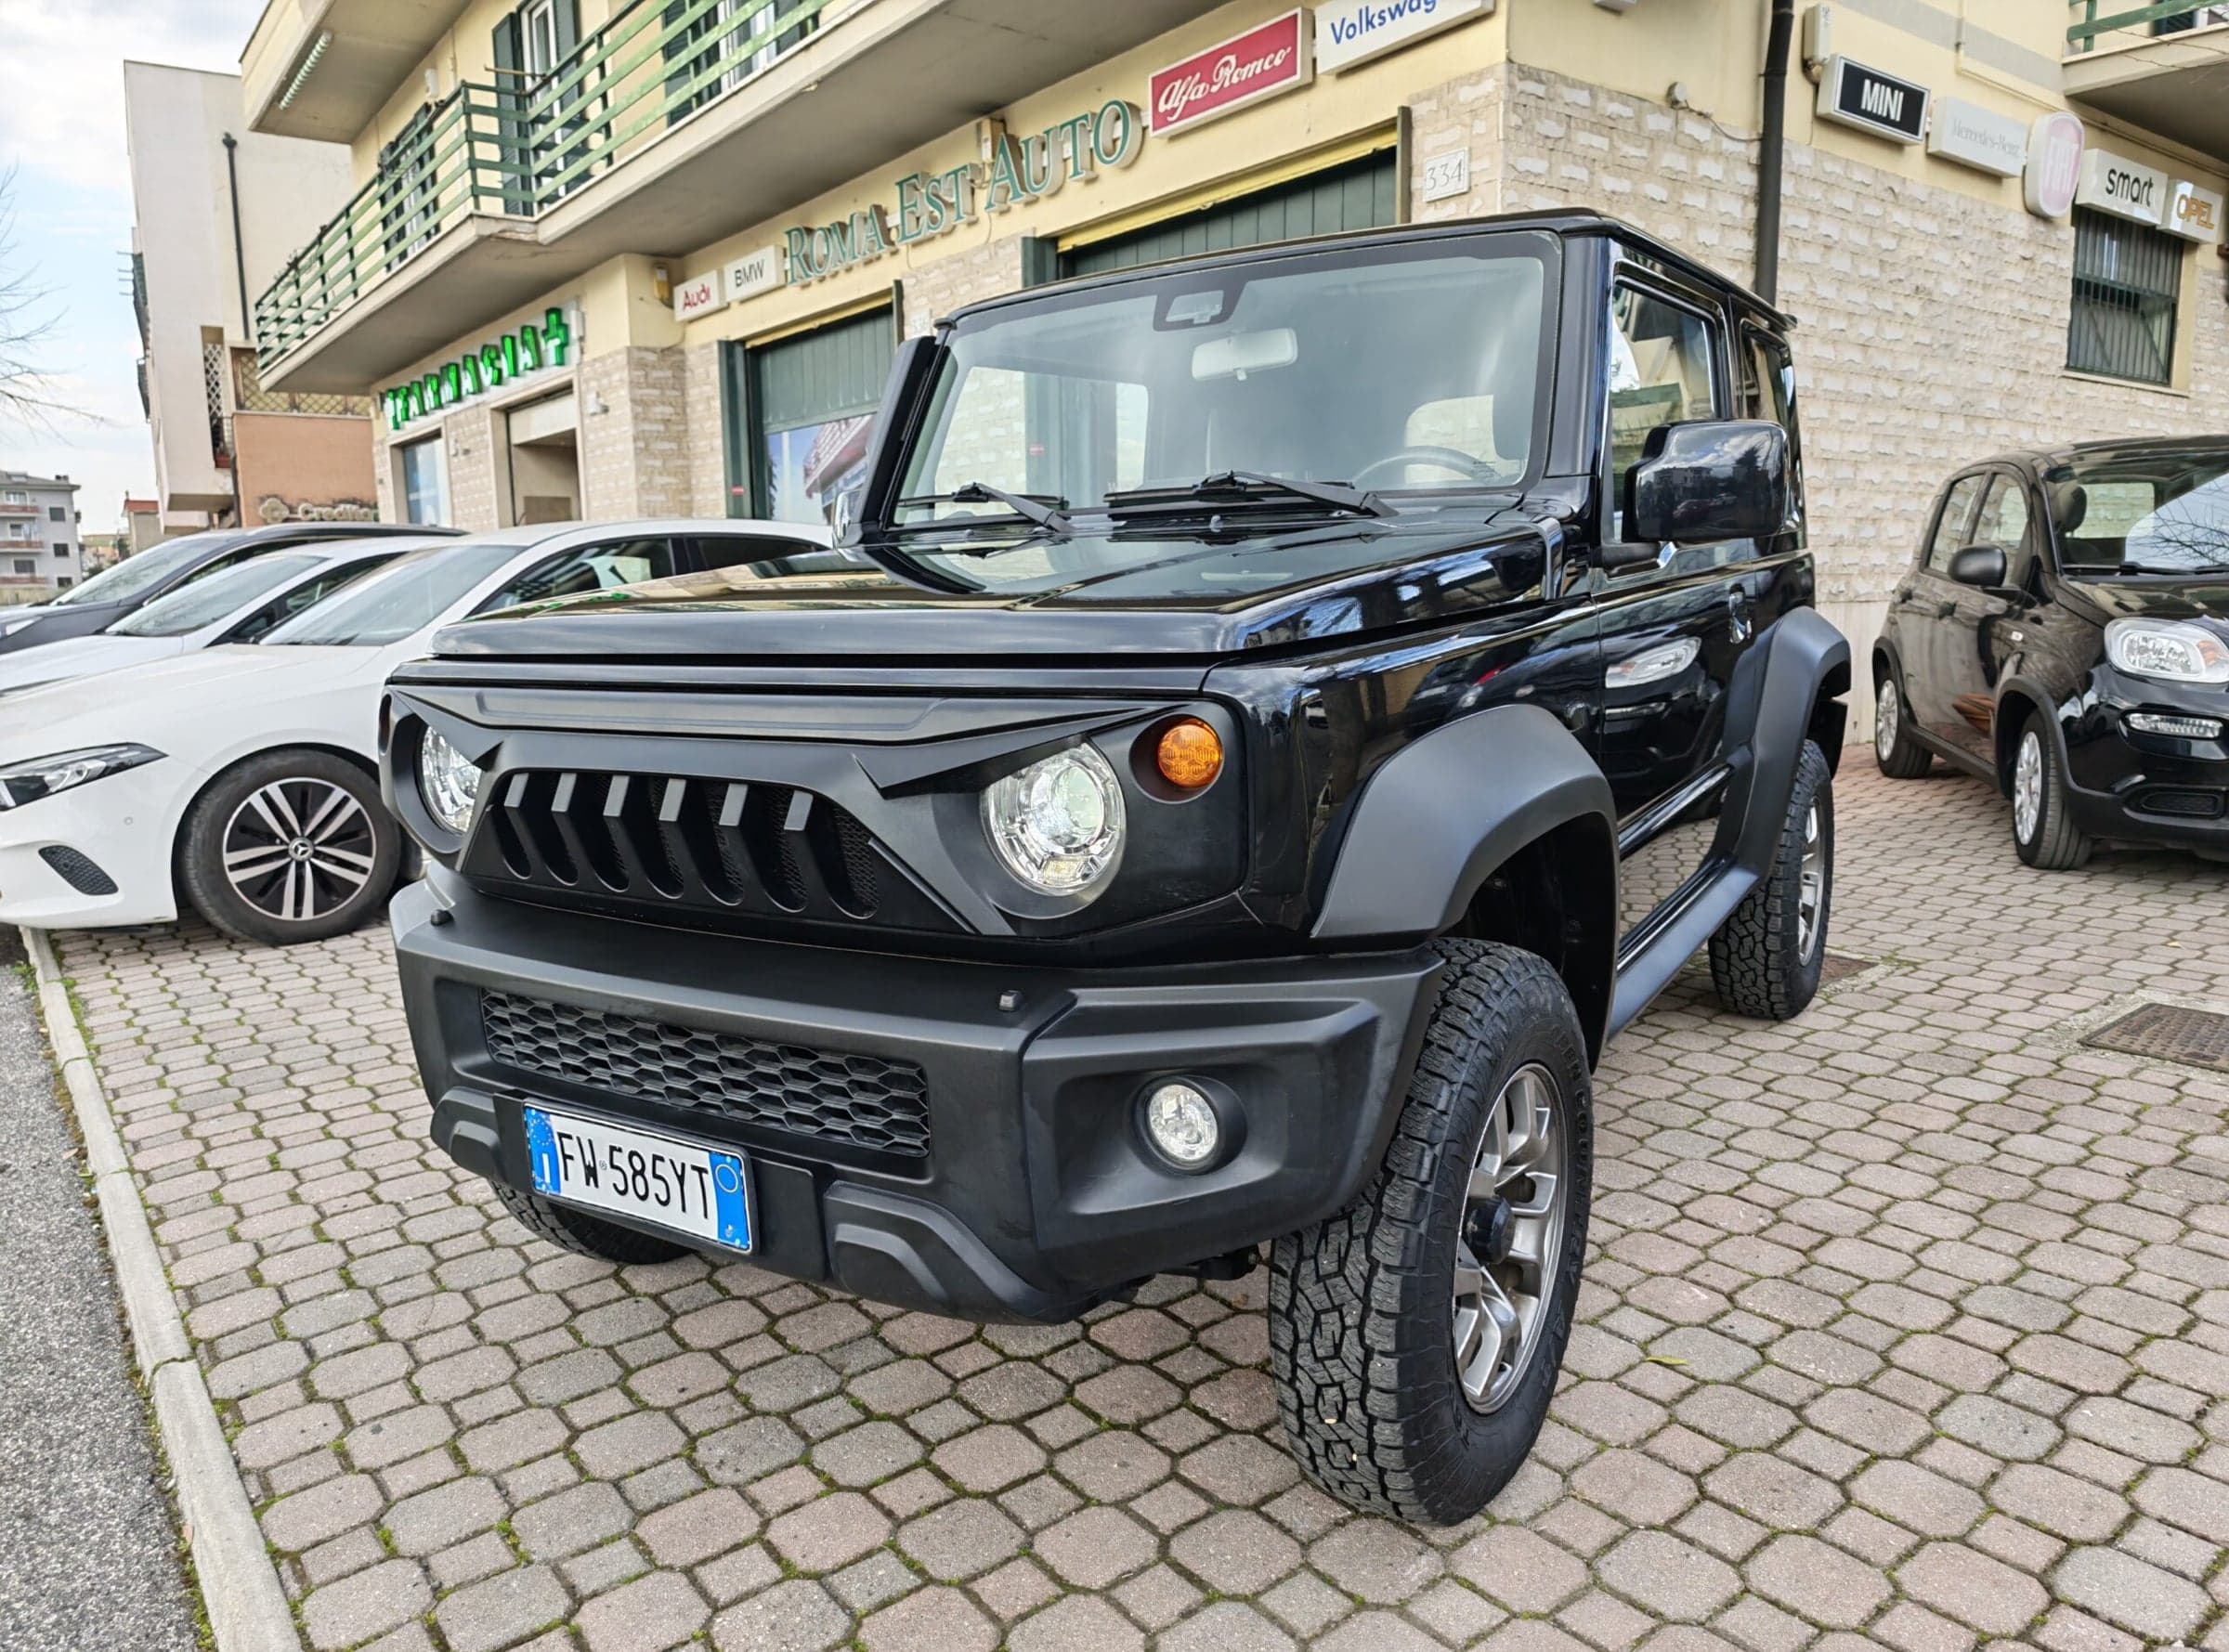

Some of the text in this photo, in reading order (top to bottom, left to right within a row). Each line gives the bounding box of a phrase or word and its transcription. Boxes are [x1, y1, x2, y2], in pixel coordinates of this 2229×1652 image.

[1158, 46, 1292, 122] Alfa Romeo
[1860, 79, 1904, 122] MINI
[1951, 117, 2021, 158] Mercedes-Benz
[785, 98, 1132, 286] ROMA EST AUTO
[1427, 158, 1463, 191] 334
[2105, 168, 2154, 207] smart
[2176, 193, 2215, 230] OPEL
[735, 258, 765, 288] BMW
[682, 283, 711, 312] Audi
